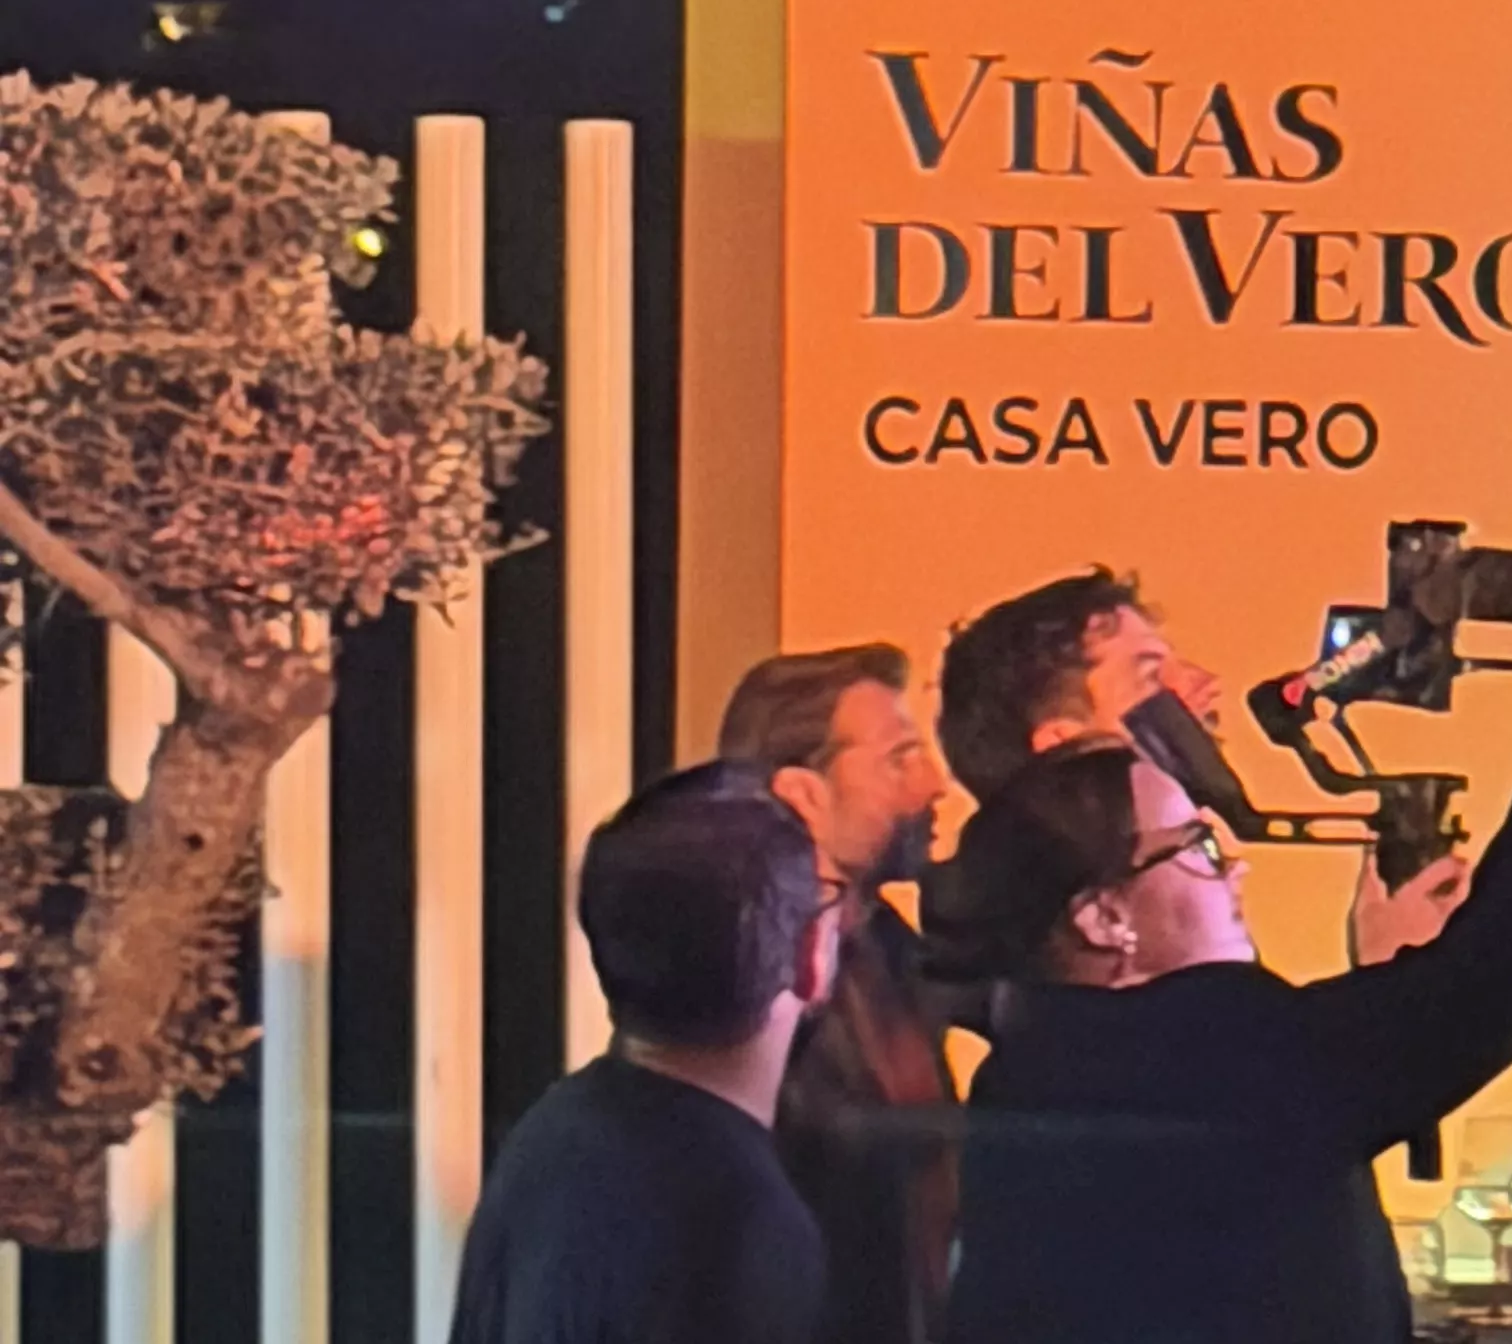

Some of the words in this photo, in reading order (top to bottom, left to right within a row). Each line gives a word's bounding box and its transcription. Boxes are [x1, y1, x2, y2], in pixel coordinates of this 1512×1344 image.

[867, 48, 1345, 183] VIÑAS
[861, 219, 1154, 325] DEL
[863, 395, 1111, 466] CASA
[1134, 398, 1380, 471] VERO
